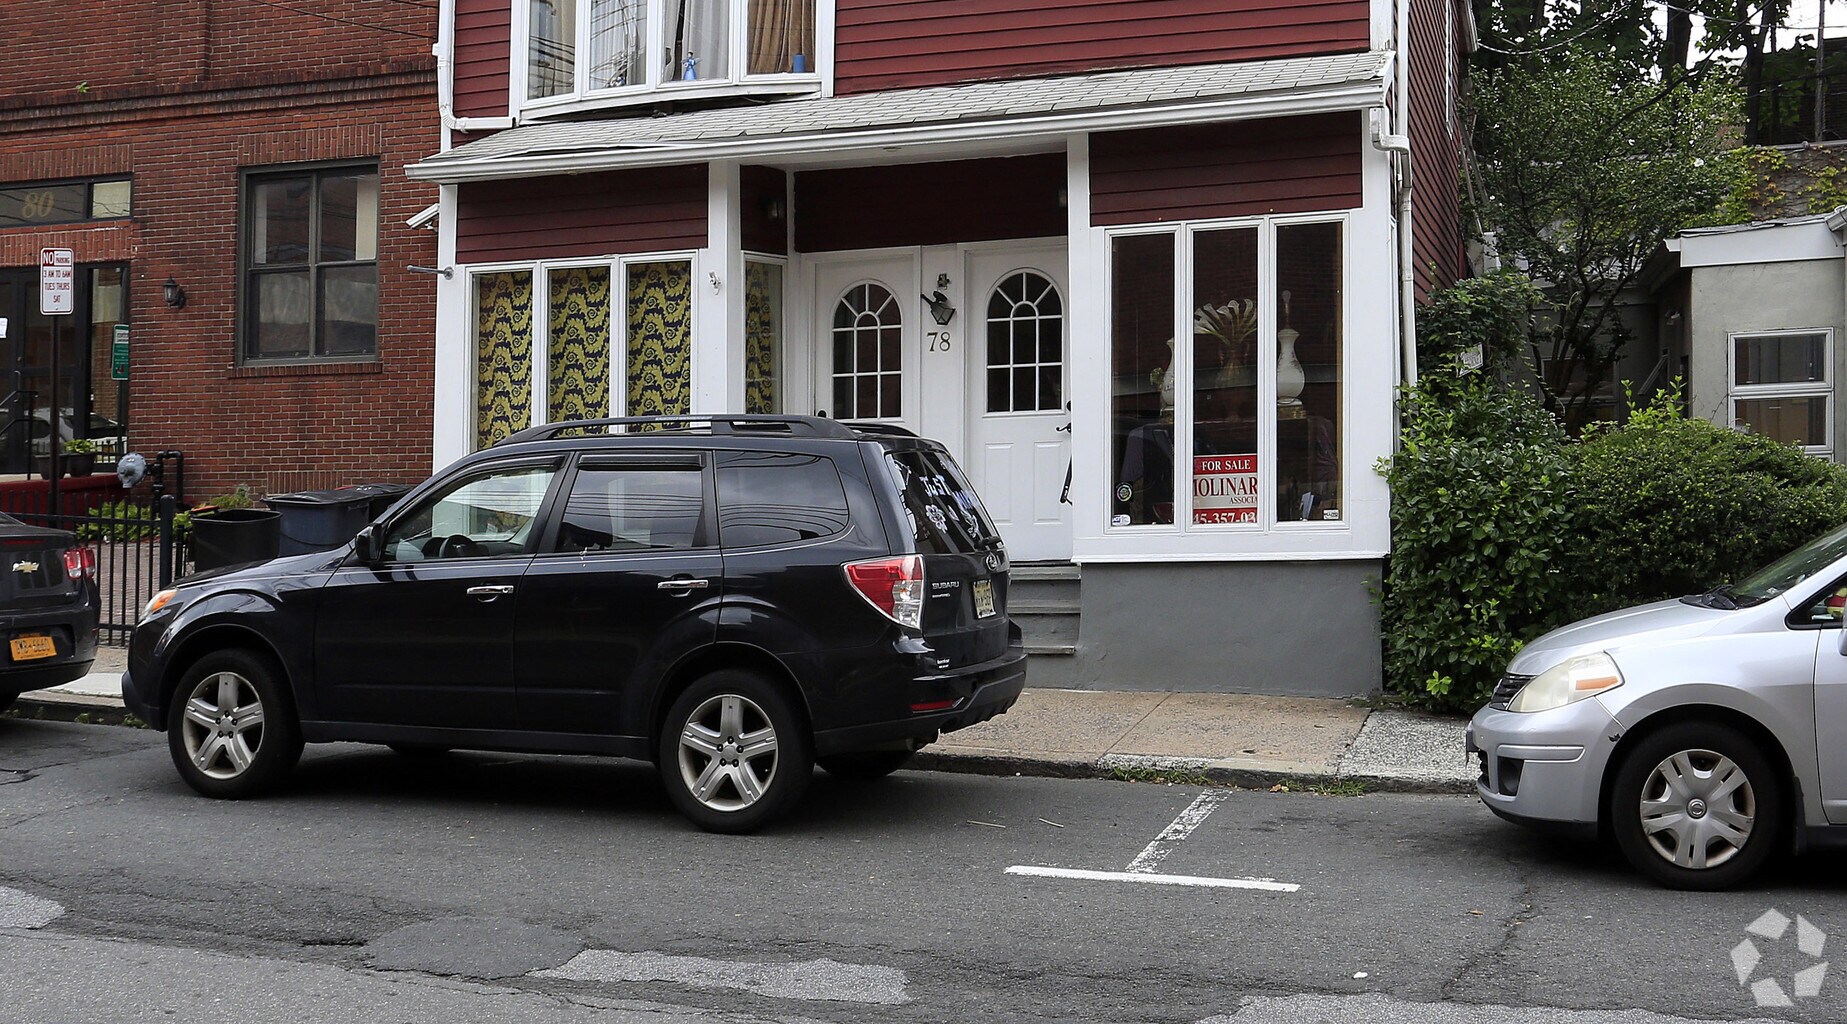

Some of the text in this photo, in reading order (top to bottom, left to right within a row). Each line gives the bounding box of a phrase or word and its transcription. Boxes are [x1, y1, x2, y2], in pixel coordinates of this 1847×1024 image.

[22, 192, 55, 218] 80
[43, 251, 54, 265] NO
[48, 270, 54, 278] AM
[55, 270, 61, 278] TO
[45, 282, 70, 290] TUES THURS
[53, 295, 61, 303] SAT
[927, 331, 950, 351] 78
[1202, 459, 1251, 471] FOR SALE
[932, 581, 960, 589] SUBARU
